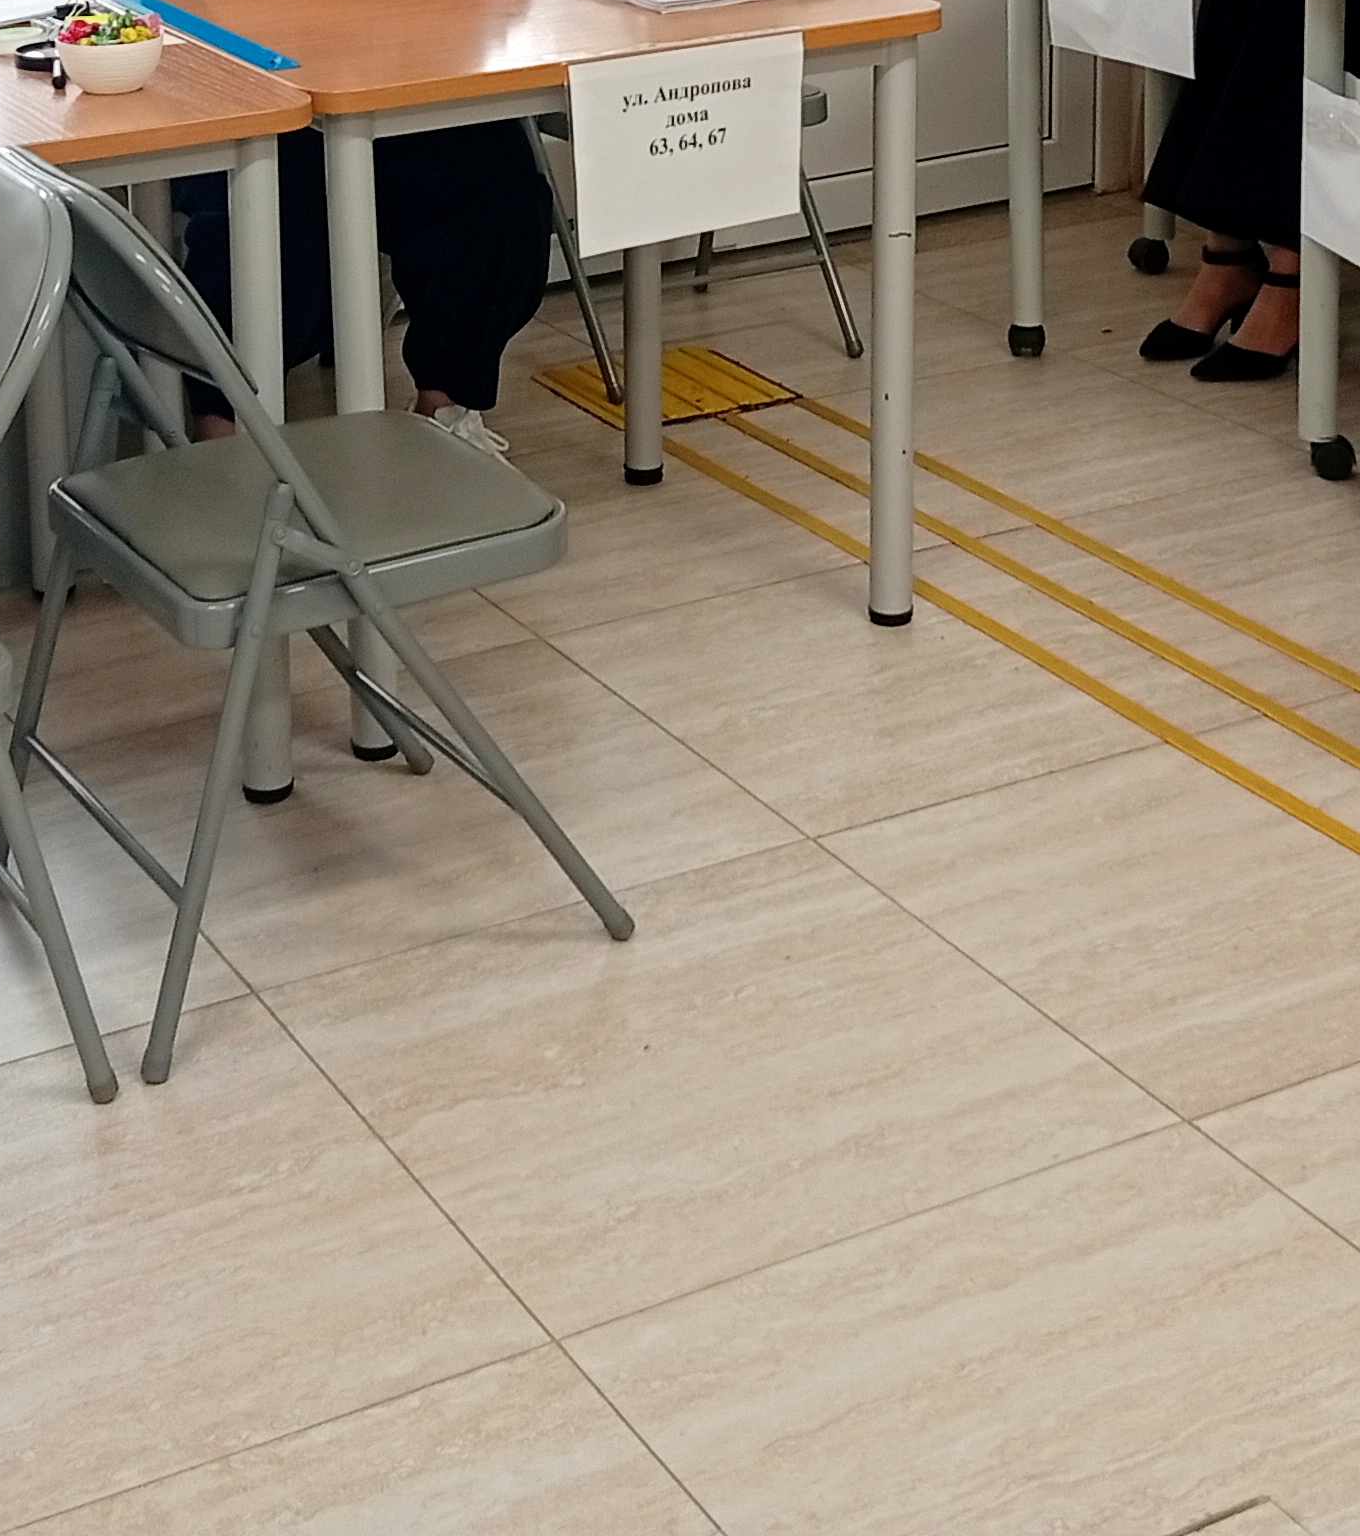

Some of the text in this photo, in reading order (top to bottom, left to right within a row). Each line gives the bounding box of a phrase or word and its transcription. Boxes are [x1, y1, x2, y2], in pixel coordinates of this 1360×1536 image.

[623, 77, 751, 112] ул. Андропова
[666, 109, 709, 128] дома
[650, 127, 726, 156] 63, 64, 67
